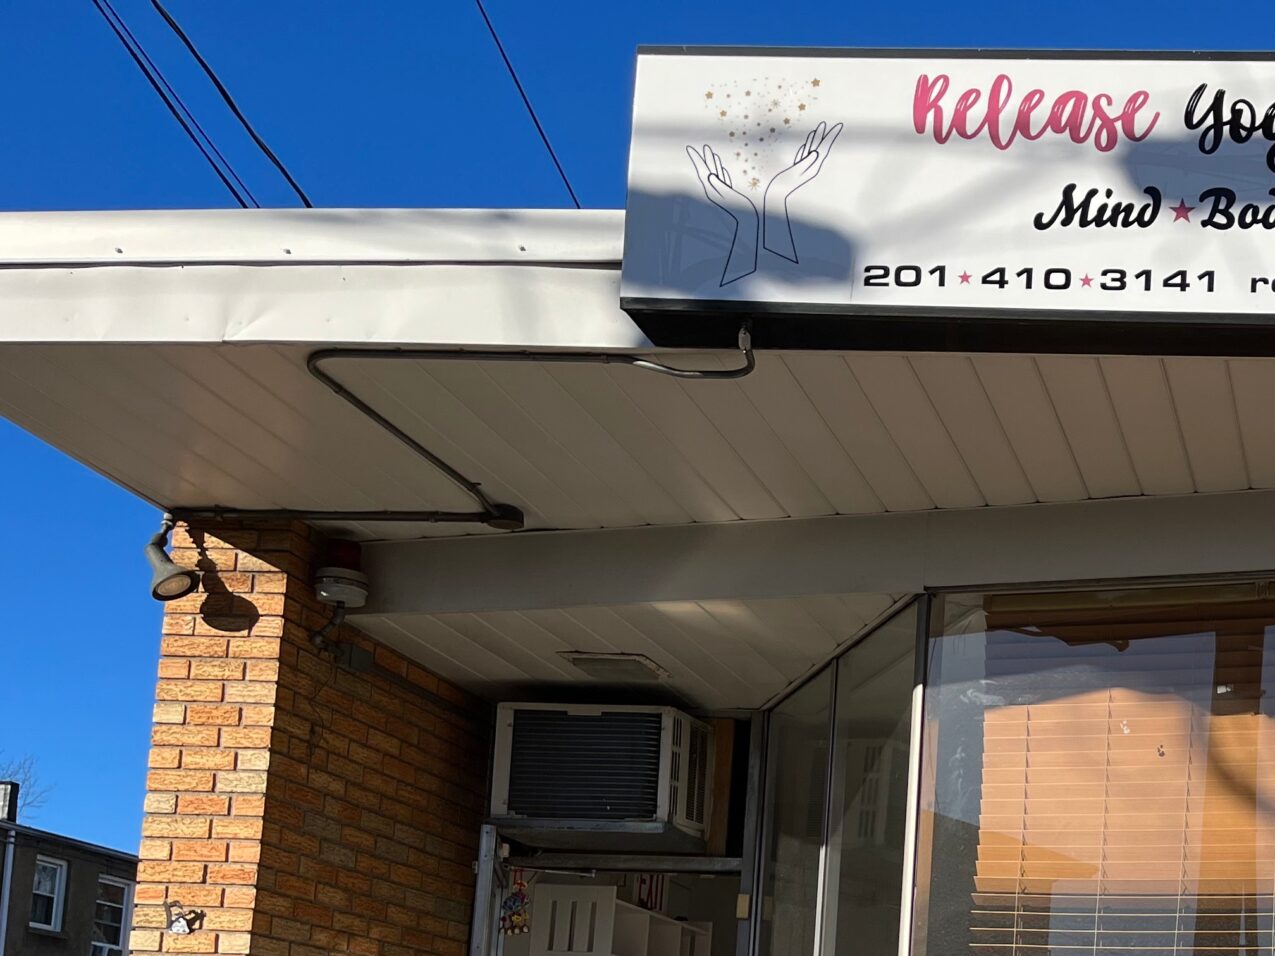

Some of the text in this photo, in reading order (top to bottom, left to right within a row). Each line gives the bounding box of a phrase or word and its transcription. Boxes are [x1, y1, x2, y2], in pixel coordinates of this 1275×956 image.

[912, 74, 1160, 152] Release
[1033, 183, 1162, 230] Mind
[863, 265, 1215, 293] 201 410 3141
